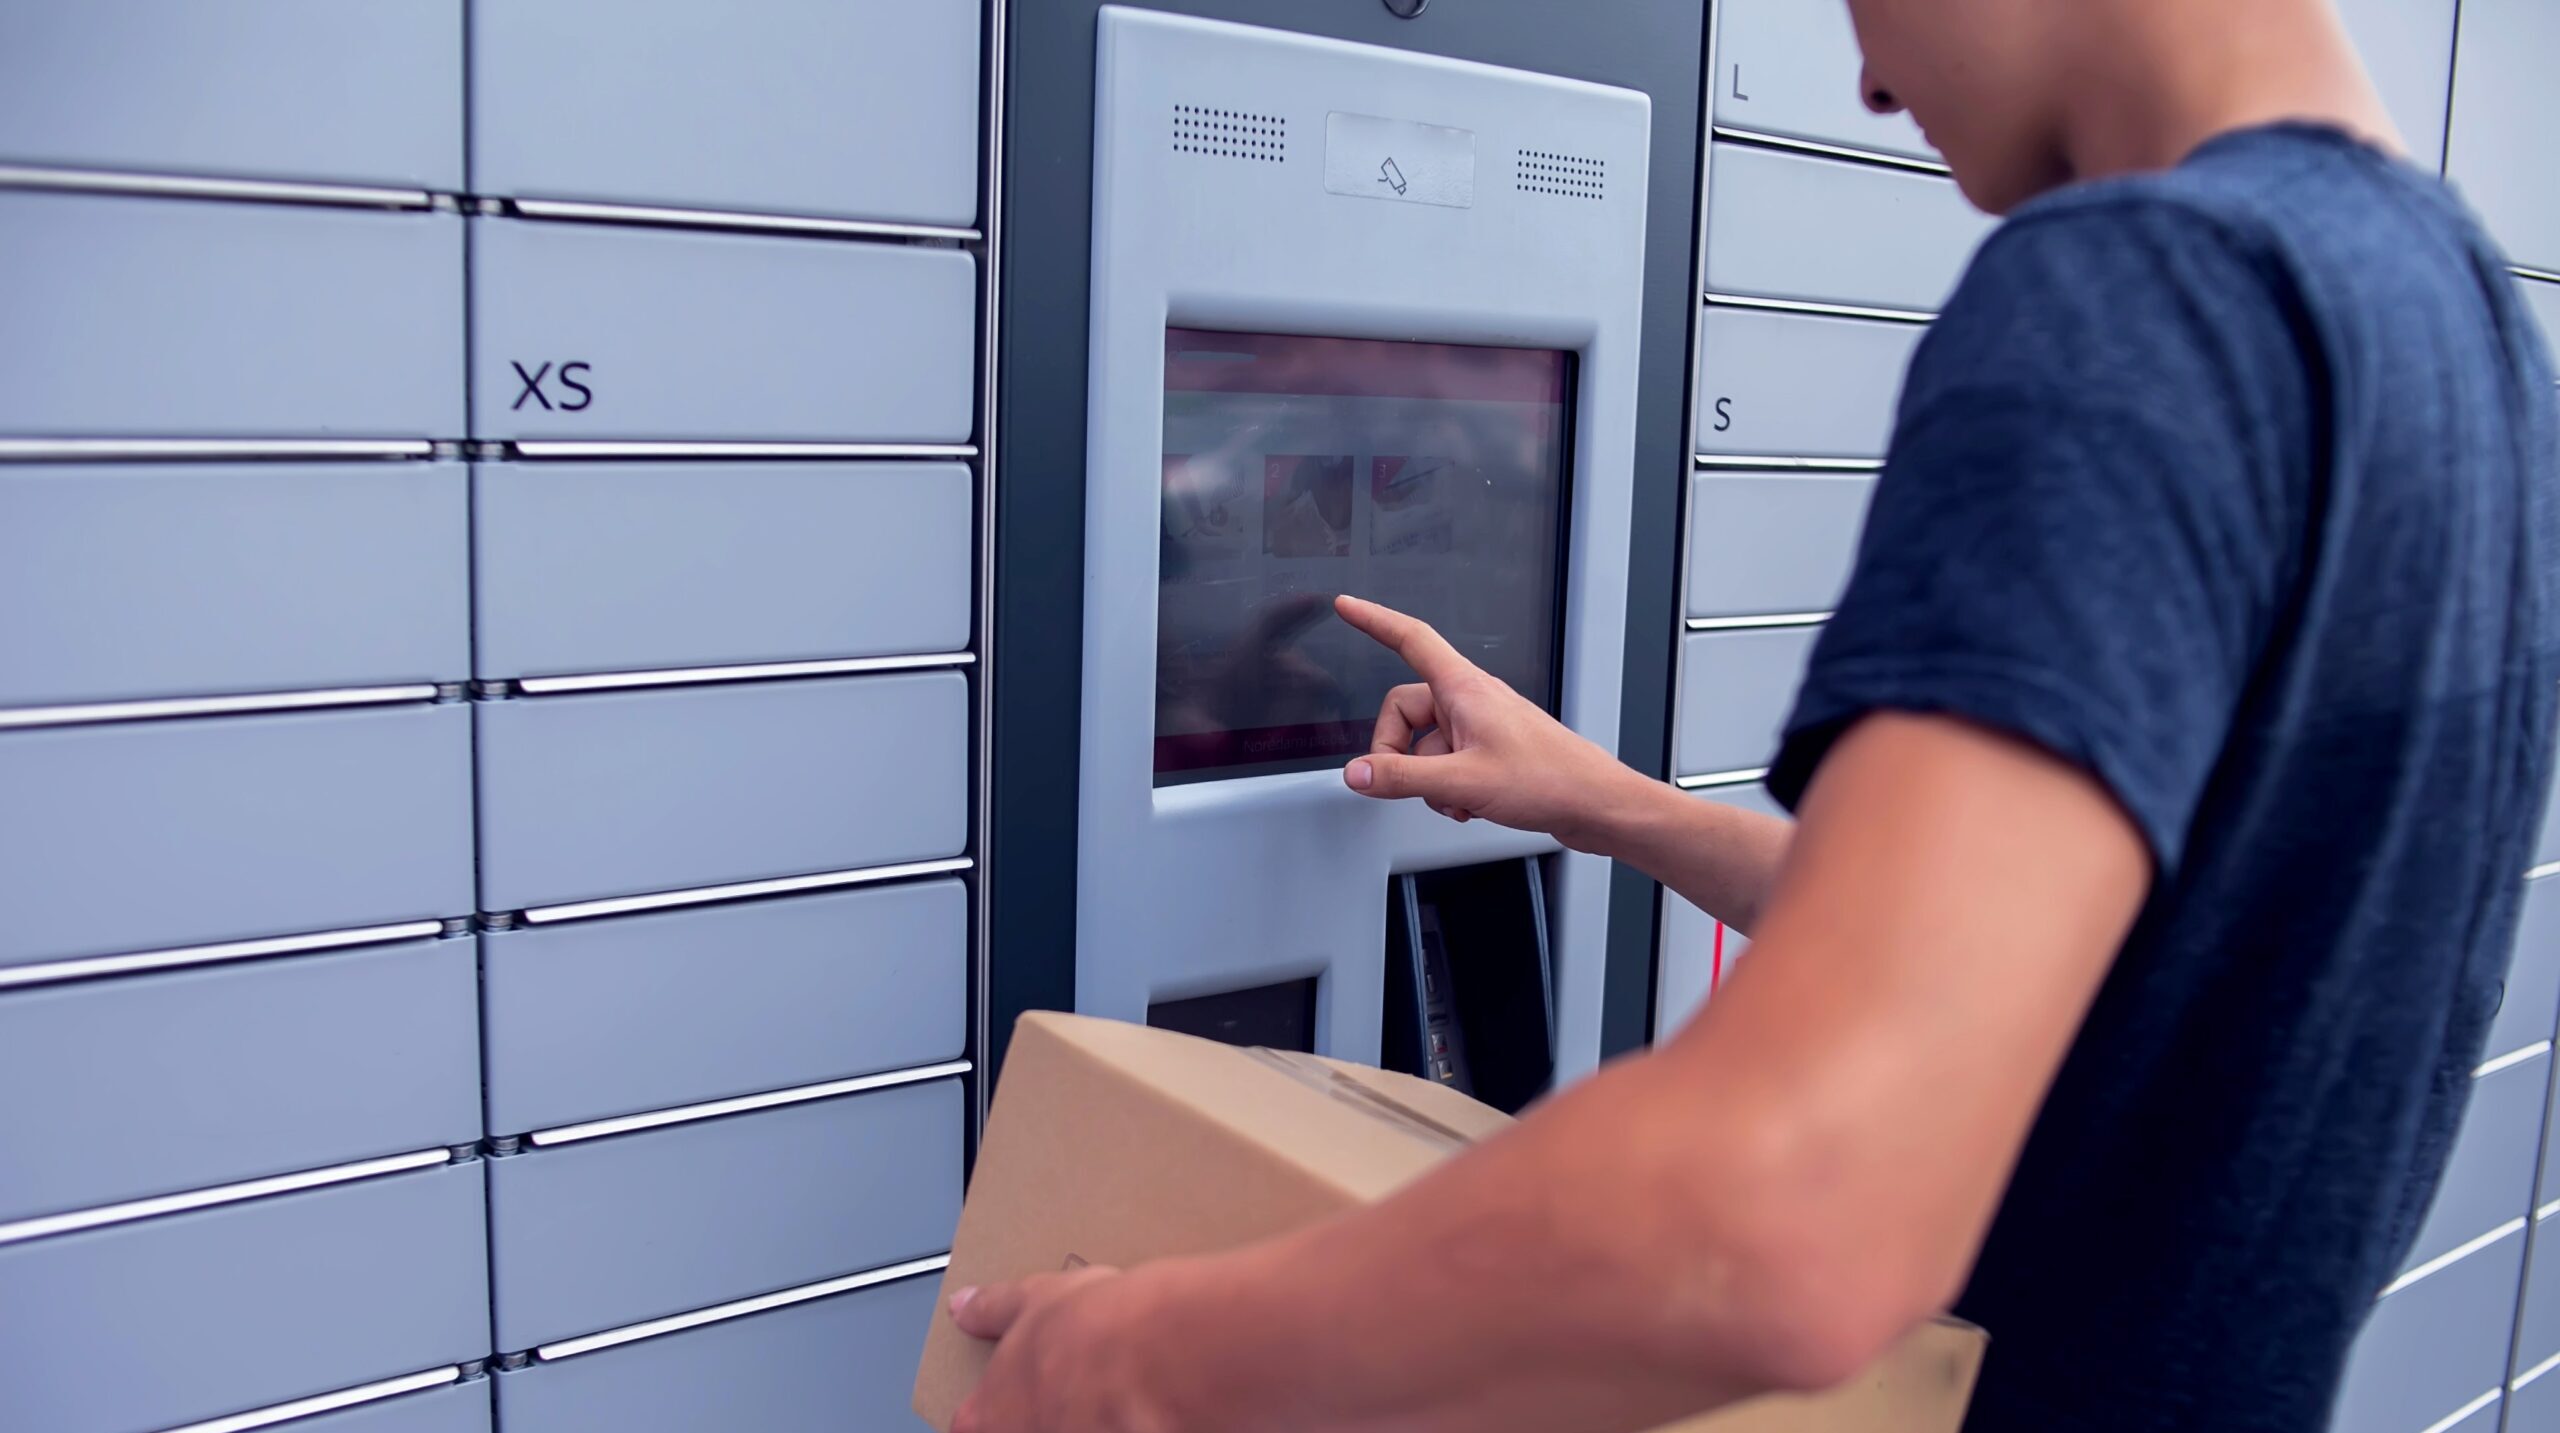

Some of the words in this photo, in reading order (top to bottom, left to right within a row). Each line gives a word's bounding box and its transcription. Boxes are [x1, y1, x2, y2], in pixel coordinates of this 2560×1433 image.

[1732, 63, 1749, 102] L
[510, 360, 593, 413] XS
[1713, 396, 1732, 433] S
[1271, 463, 1281, 479] 2
